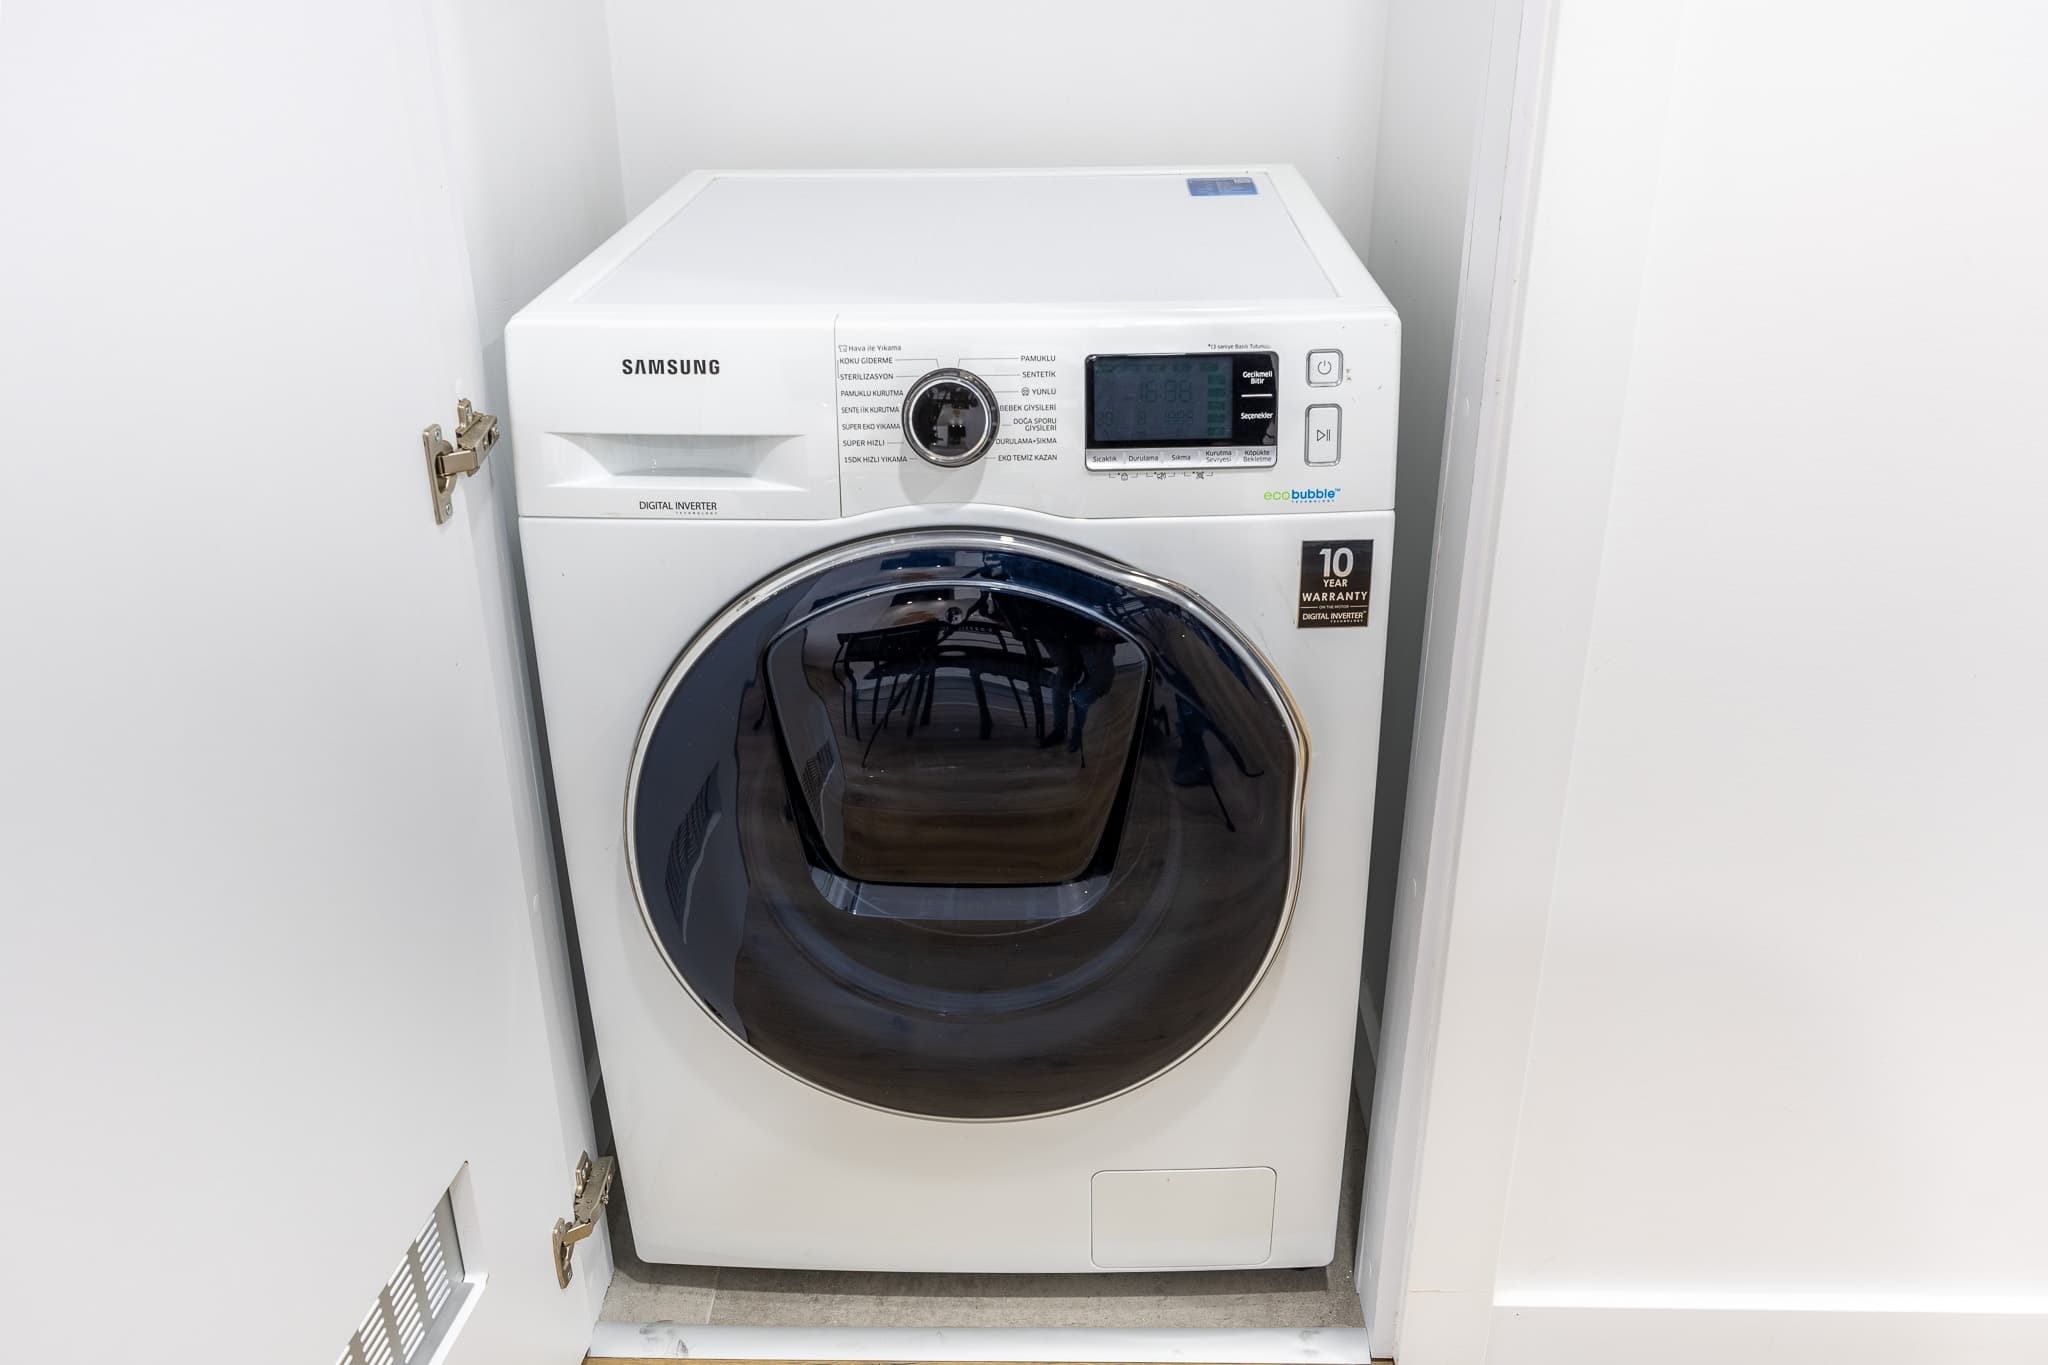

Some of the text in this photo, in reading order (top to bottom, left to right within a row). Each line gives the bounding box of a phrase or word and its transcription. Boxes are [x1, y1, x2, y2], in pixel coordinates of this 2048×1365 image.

[622, 359, 720, 375] SAMSUNG
[872, 389, 904, 397] KURUTMA
[1000, 404, 1022, 412] BEBEK
[998, 454, 1012, 462] EKO
[639, 501, 718, 511] DIGITAL INVERTER
[1319, 547, 1354, 577] 10
[1323, 579, 1348, 587] YEAR
[1302, 591, 1368, 602] WARRANTY
[1302, 612, 1364, 620] DIGITAL INVERTER
